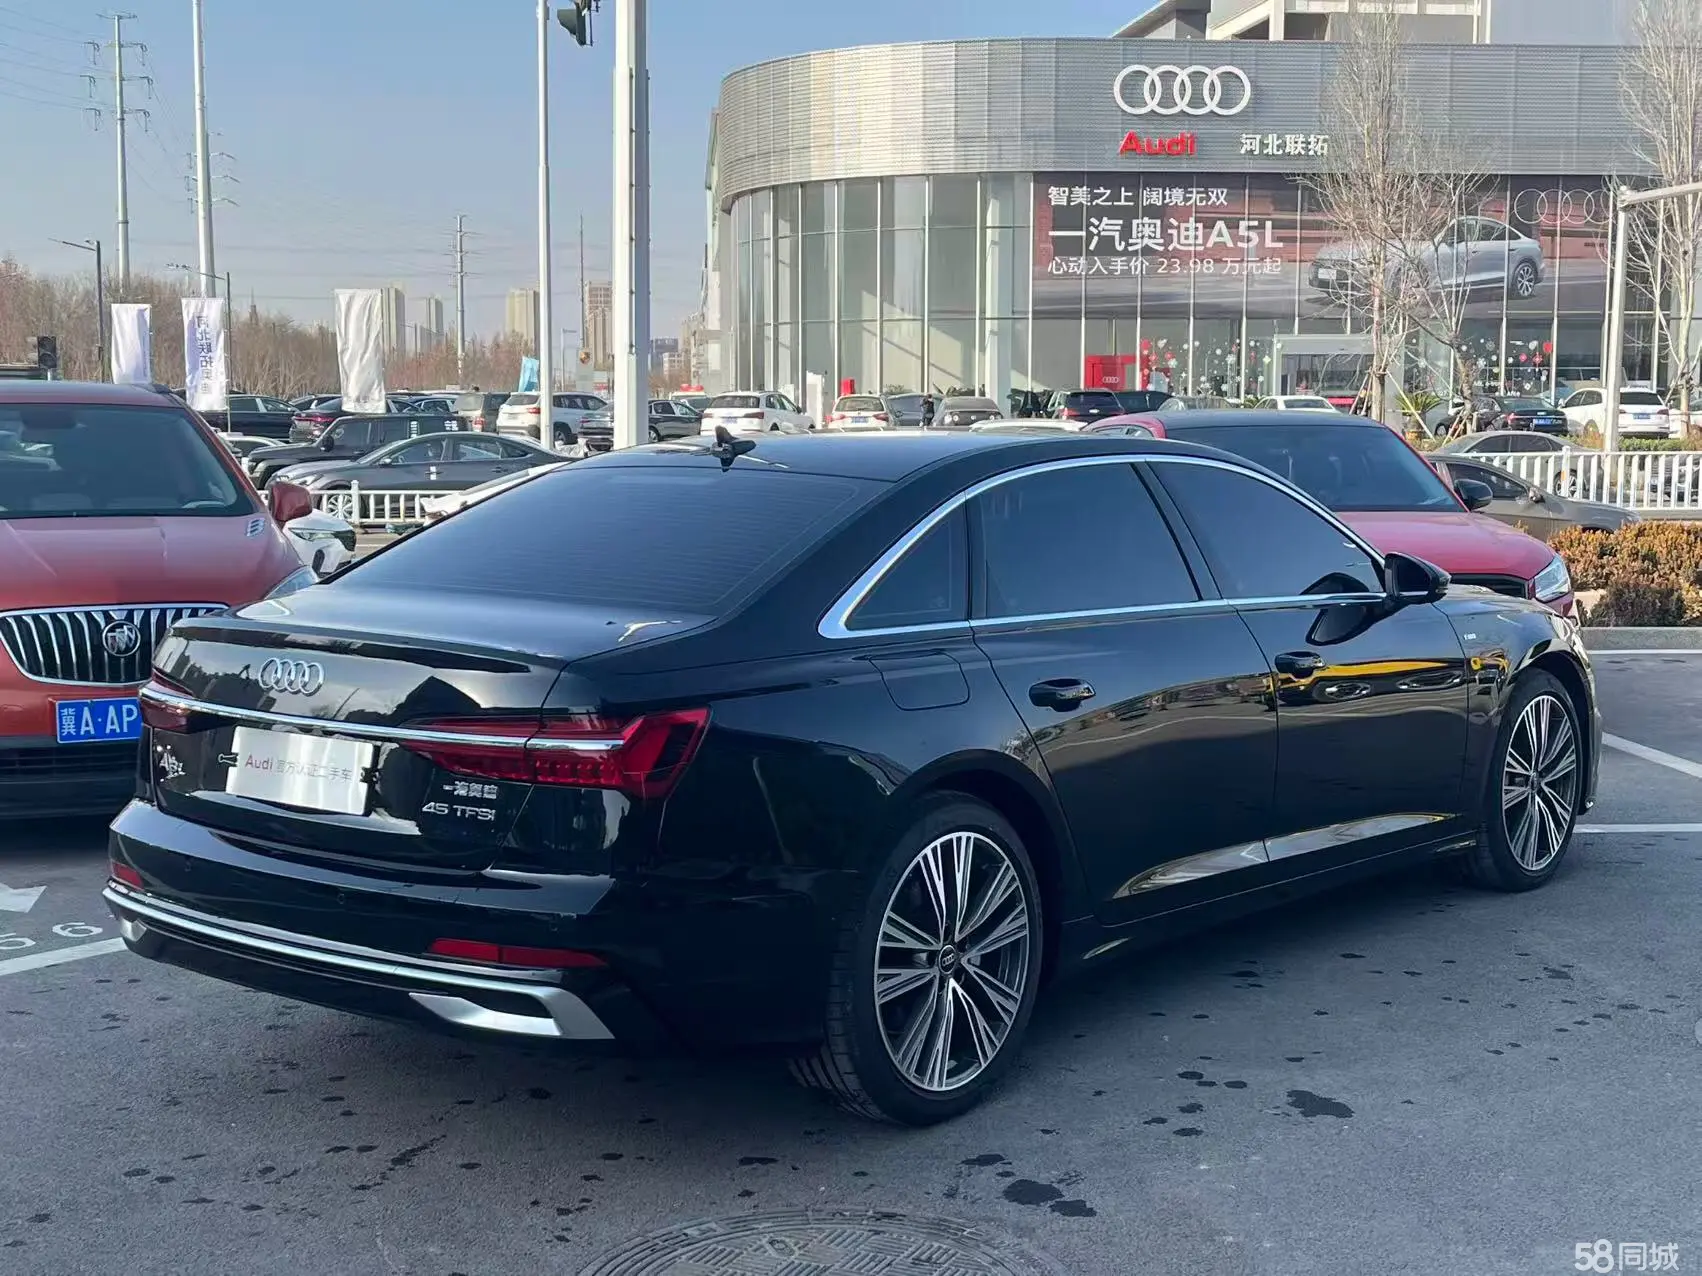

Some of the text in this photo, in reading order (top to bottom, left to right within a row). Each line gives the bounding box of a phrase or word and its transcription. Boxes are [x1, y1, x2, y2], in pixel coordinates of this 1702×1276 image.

[1118, 130, 1198, 156] Audi
[1240, 133, 1329, 155] 河北联拓
[1048, 186, 1228, 206] 智美之上 阔境无双
[1048, 216, 1284, 251] 一汽奥迪A5L
[1048, 256, 1281, 275] 心动入手价 23.98 万元起
[61, 704, 138, 736] 冀A·AP
[244, 754, 353, 783] Audi 官方认证二手车
[422, 801, 449, 815] 45
